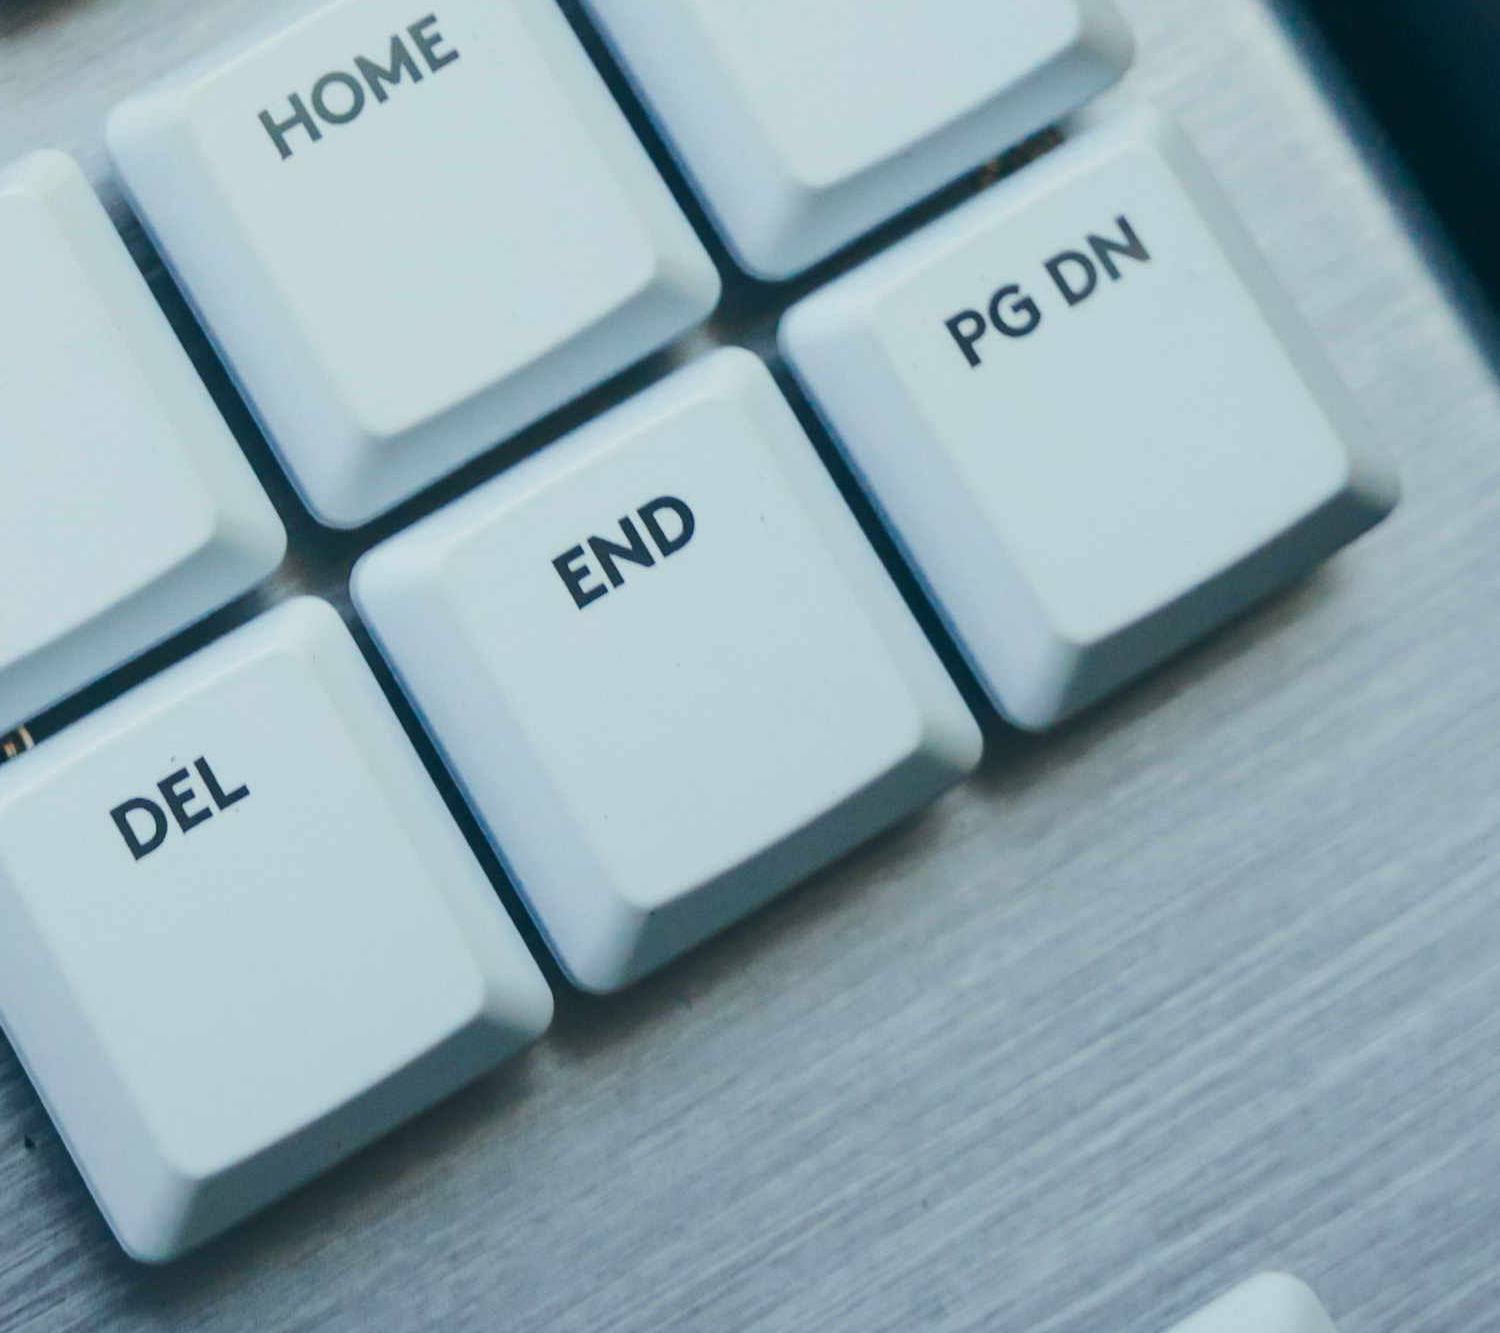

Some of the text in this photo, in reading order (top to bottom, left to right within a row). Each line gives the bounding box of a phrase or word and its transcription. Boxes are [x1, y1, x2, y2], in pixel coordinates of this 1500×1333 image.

[257, 13, 461, 161] HOME
[944, 215, 1150, 369] PG DN
[551, 495, 696, 610] END
[109, 756, 251, 861] DEL
